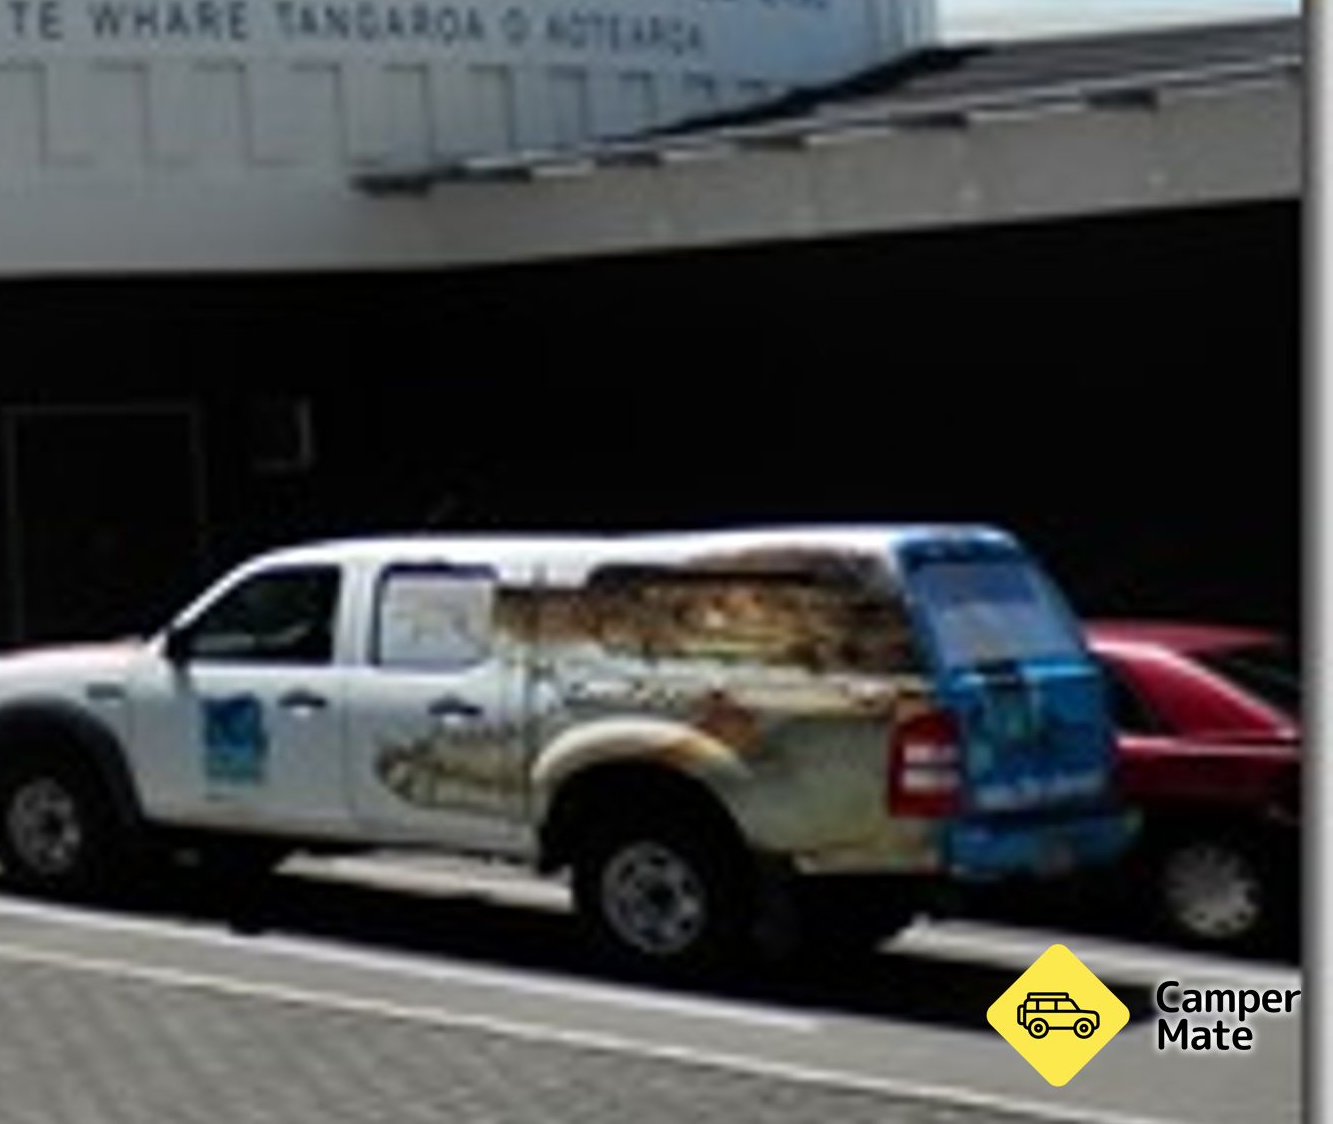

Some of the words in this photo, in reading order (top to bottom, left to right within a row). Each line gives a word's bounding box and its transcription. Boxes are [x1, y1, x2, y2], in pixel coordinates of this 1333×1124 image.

[7, 0, 64, 40] TE
[89, 0, 248, 42] WHARE
[275, 1, 484, 46] TANGAROA
[500, 7, 527, 45] O
